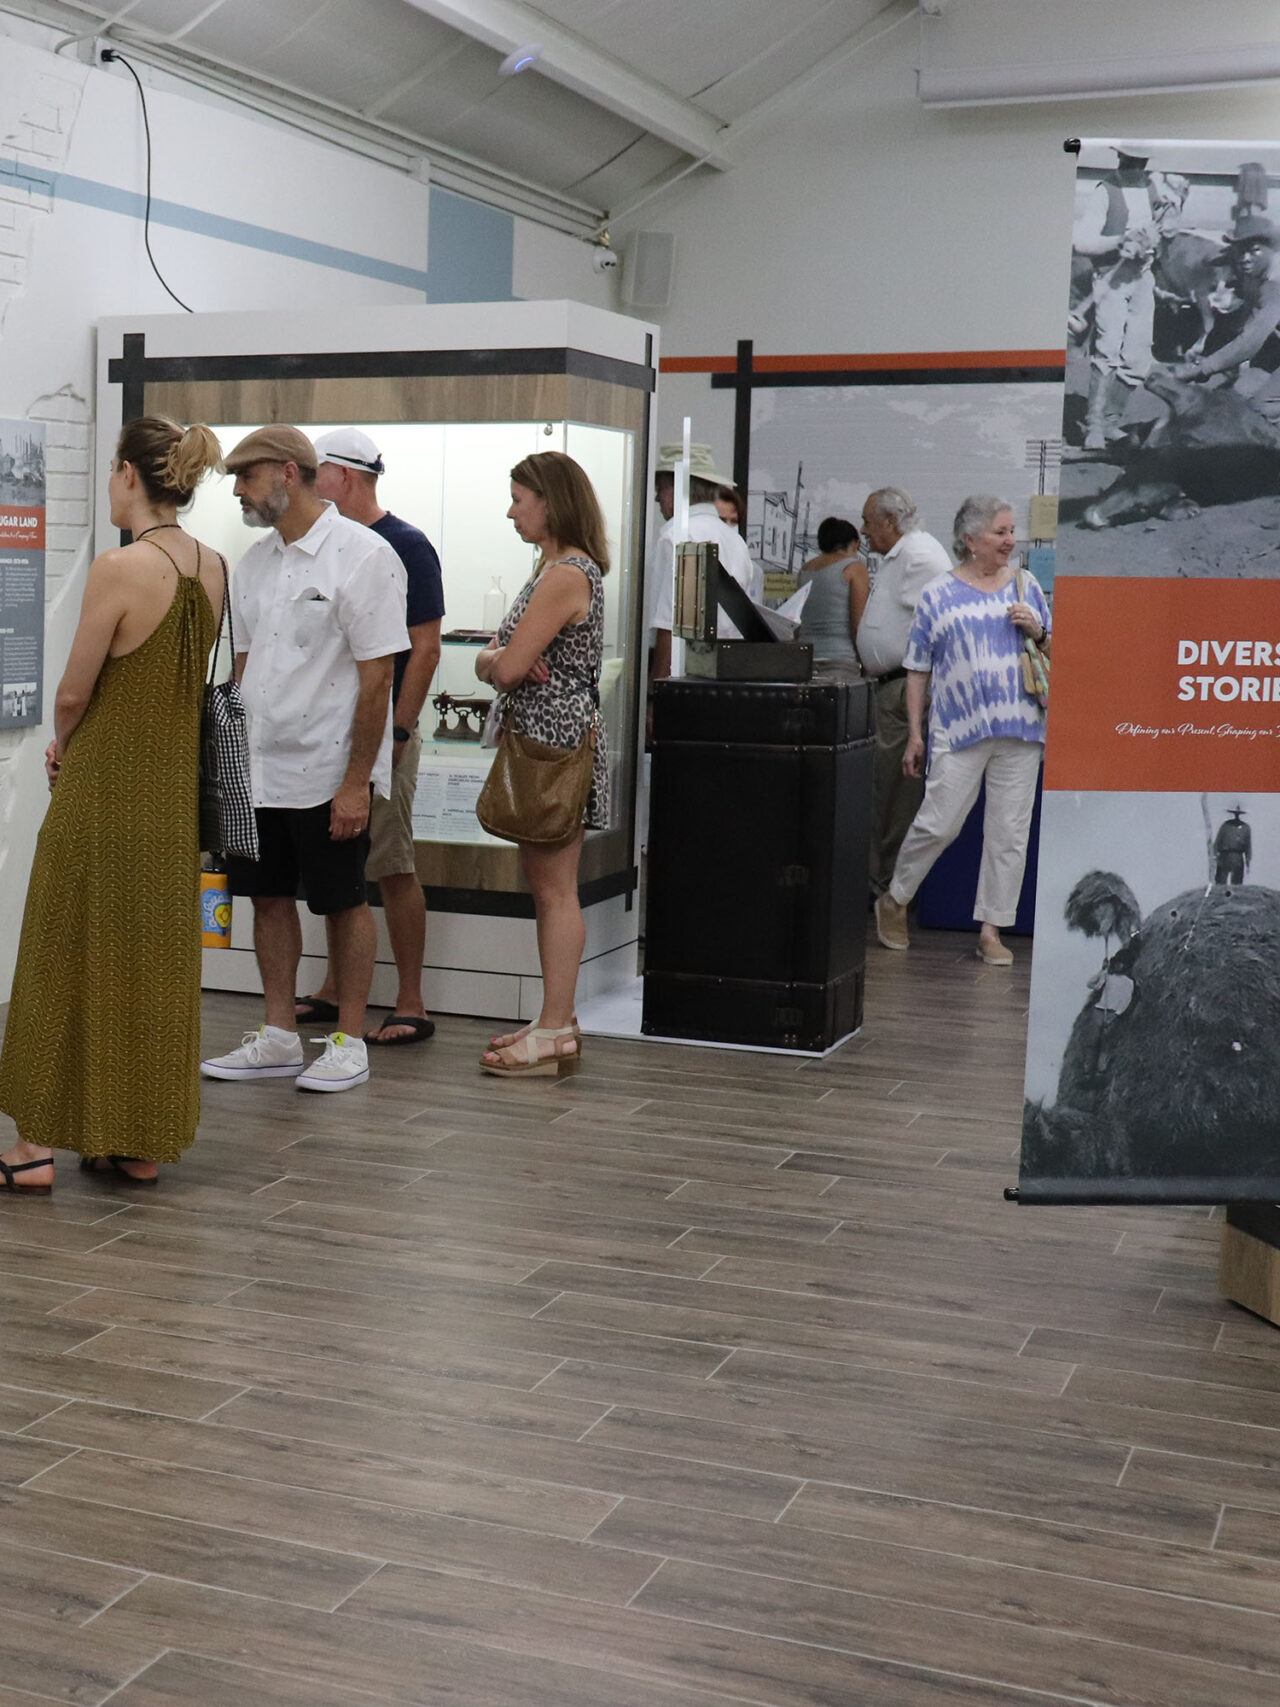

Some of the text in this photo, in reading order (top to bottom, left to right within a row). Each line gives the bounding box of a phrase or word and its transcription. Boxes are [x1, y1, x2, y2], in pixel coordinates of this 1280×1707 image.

[19, 516, 38, 528] LAND
[1114, 722, 1159, 739] Defining
[1216, 722, 1257, 740] Shaping
[1258, 728, 1273, 736] our
